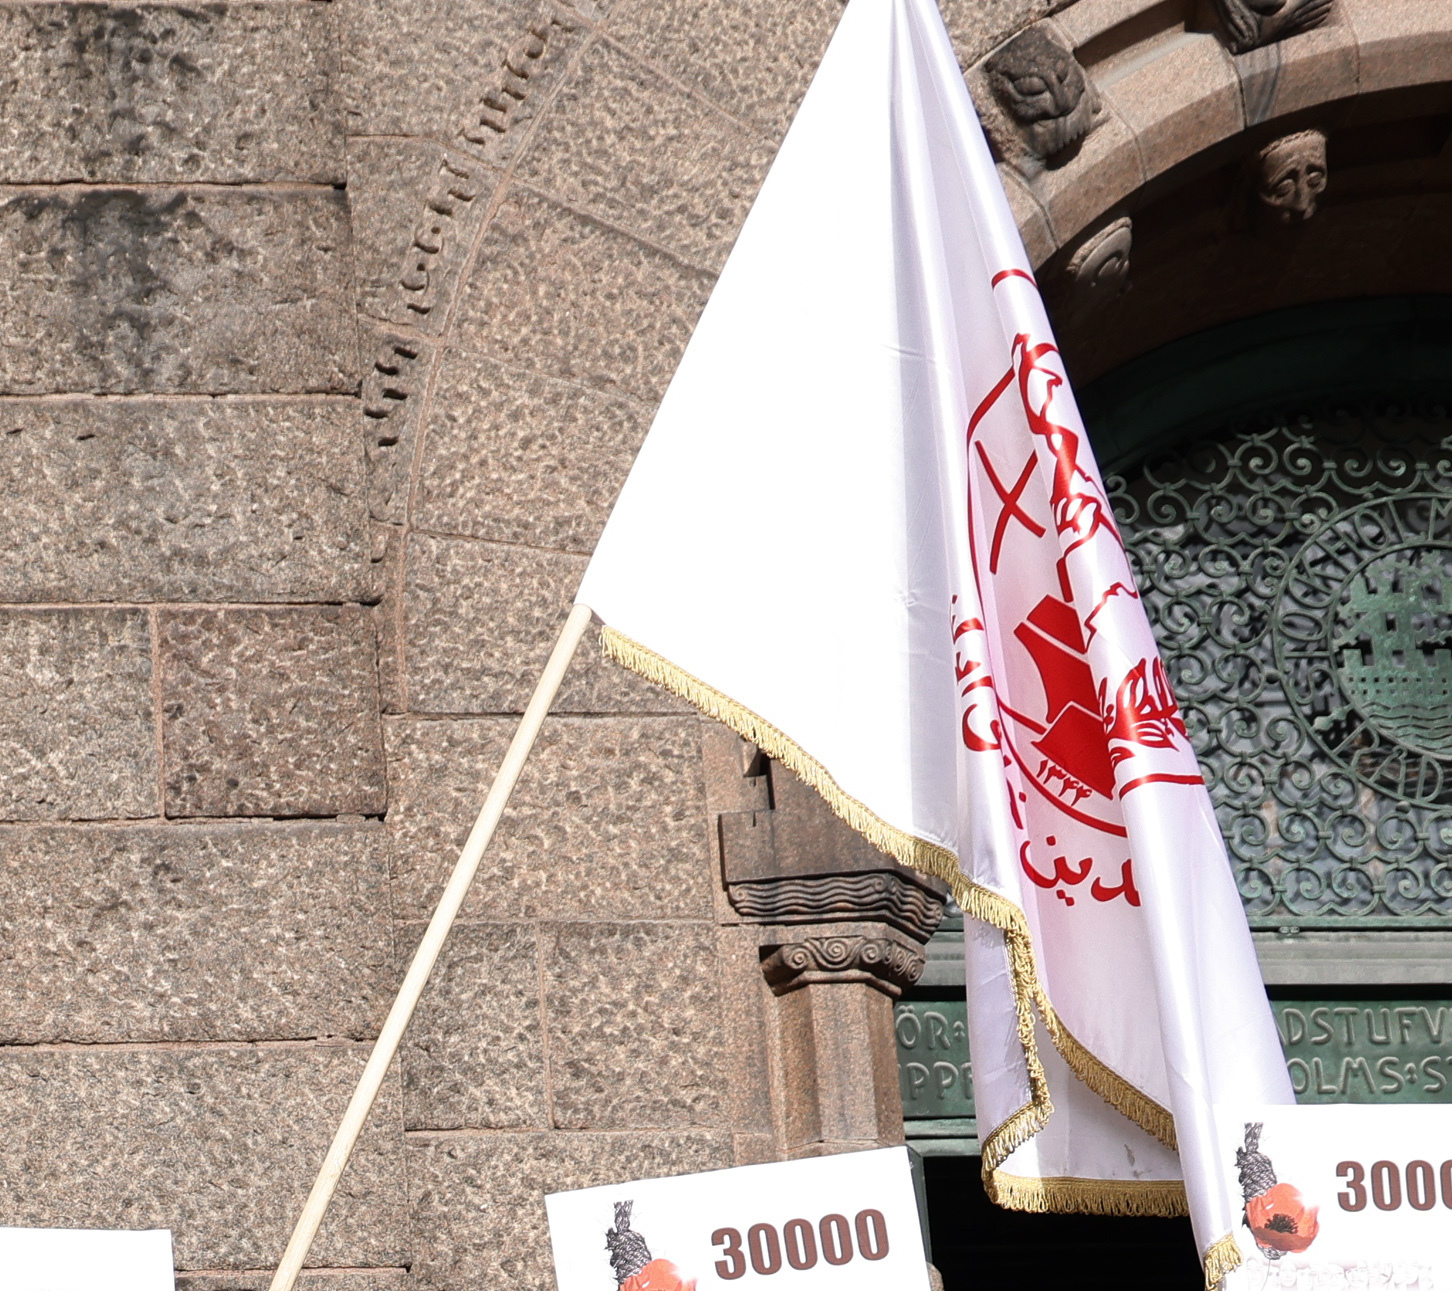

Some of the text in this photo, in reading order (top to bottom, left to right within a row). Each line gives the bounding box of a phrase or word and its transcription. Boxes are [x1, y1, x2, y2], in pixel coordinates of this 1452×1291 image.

[896, 1004, 951, 1050] ÖR
[1286, 1056, 1403, 1094] OLMS
[710, 1207, 889, 1281] 30000
